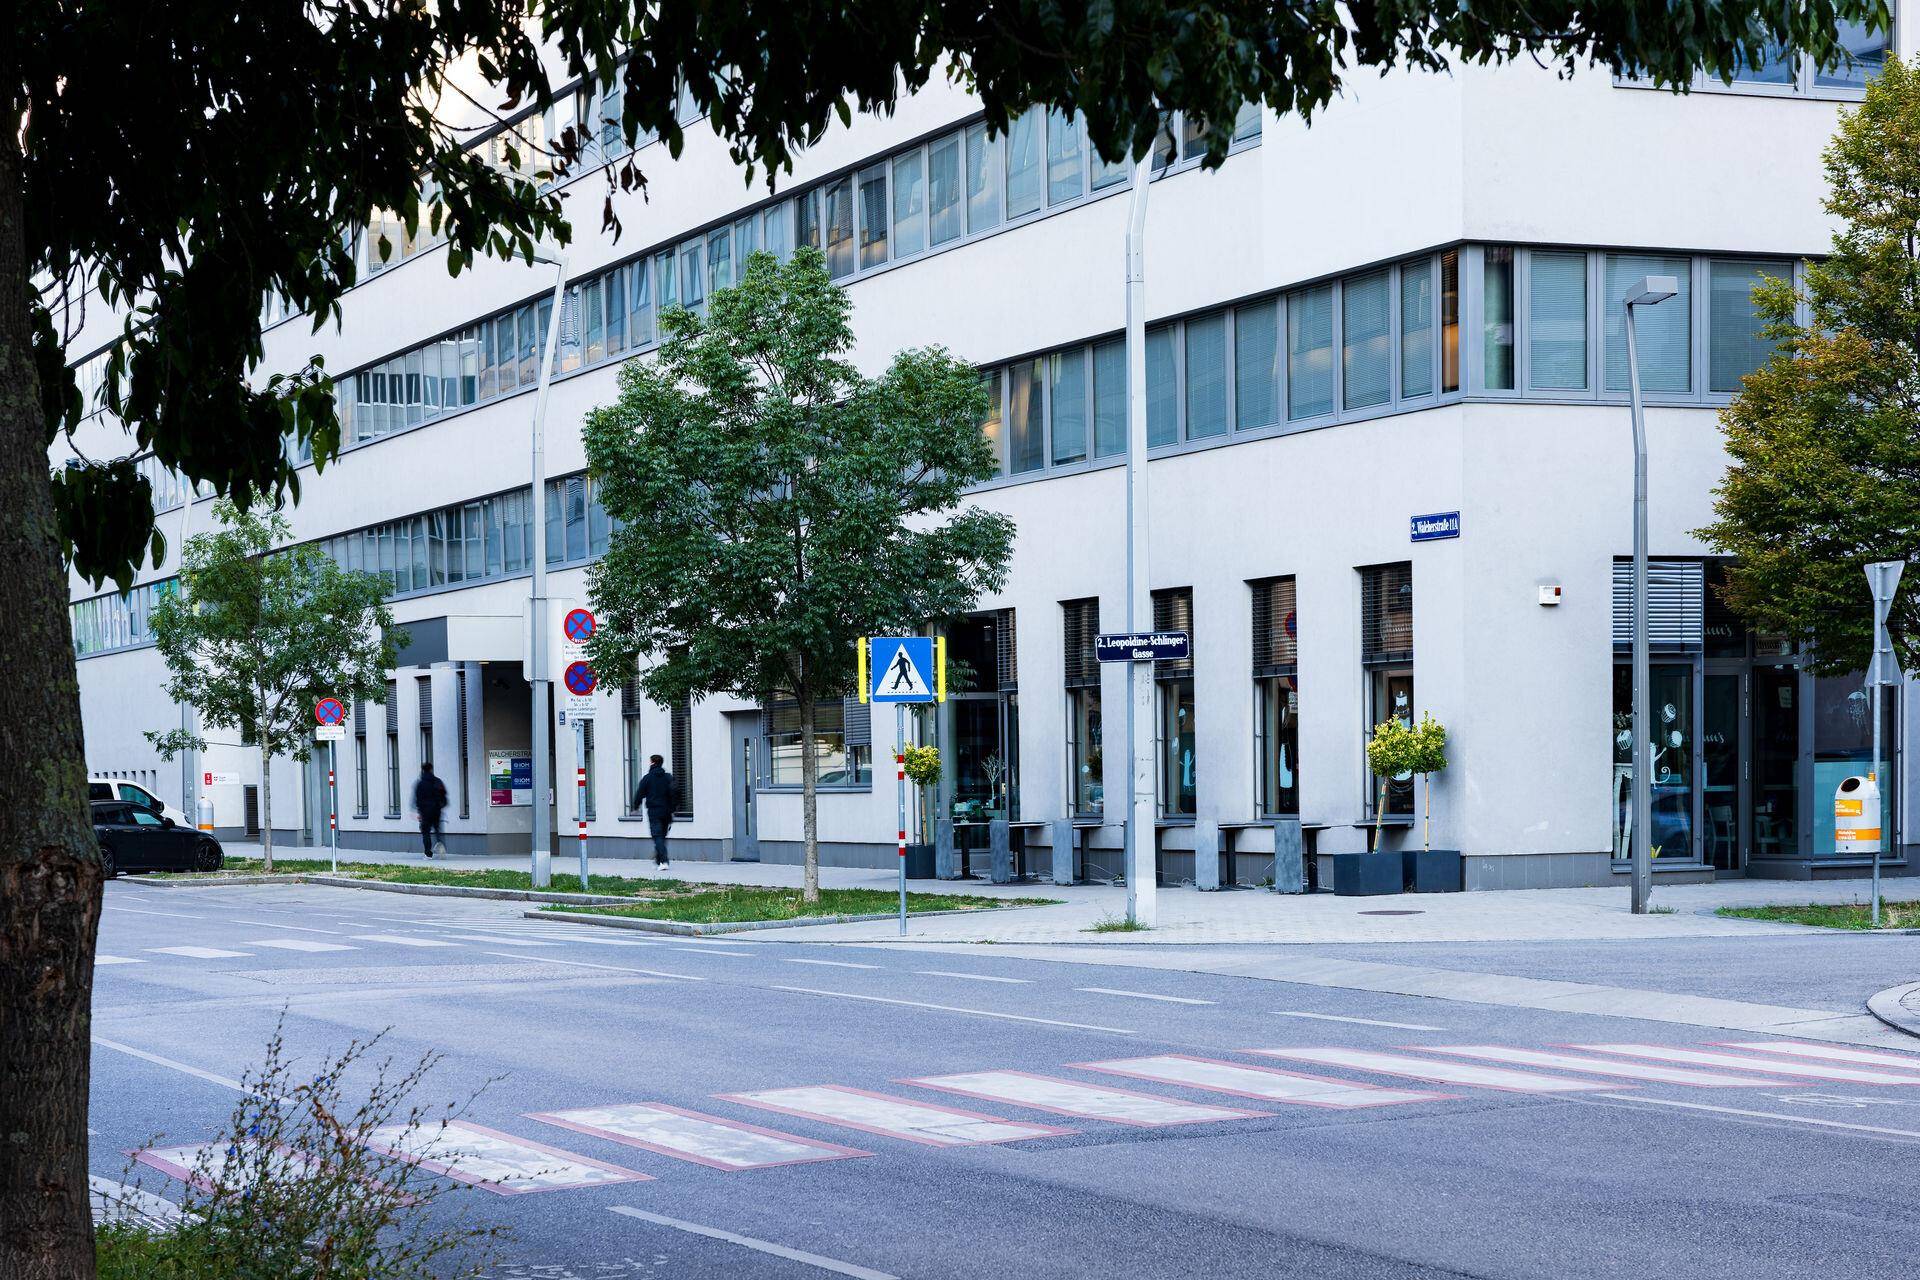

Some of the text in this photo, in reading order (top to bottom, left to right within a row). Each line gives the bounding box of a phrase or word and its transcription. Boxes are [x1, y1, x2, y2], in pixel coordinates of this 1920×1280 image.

[1417, 519, 1449, 534] Walcherstraße
[1107, 636, 1186, 649] Leopoldine-Schlinger-
[1132, 648, 1154, 658] Gasse
